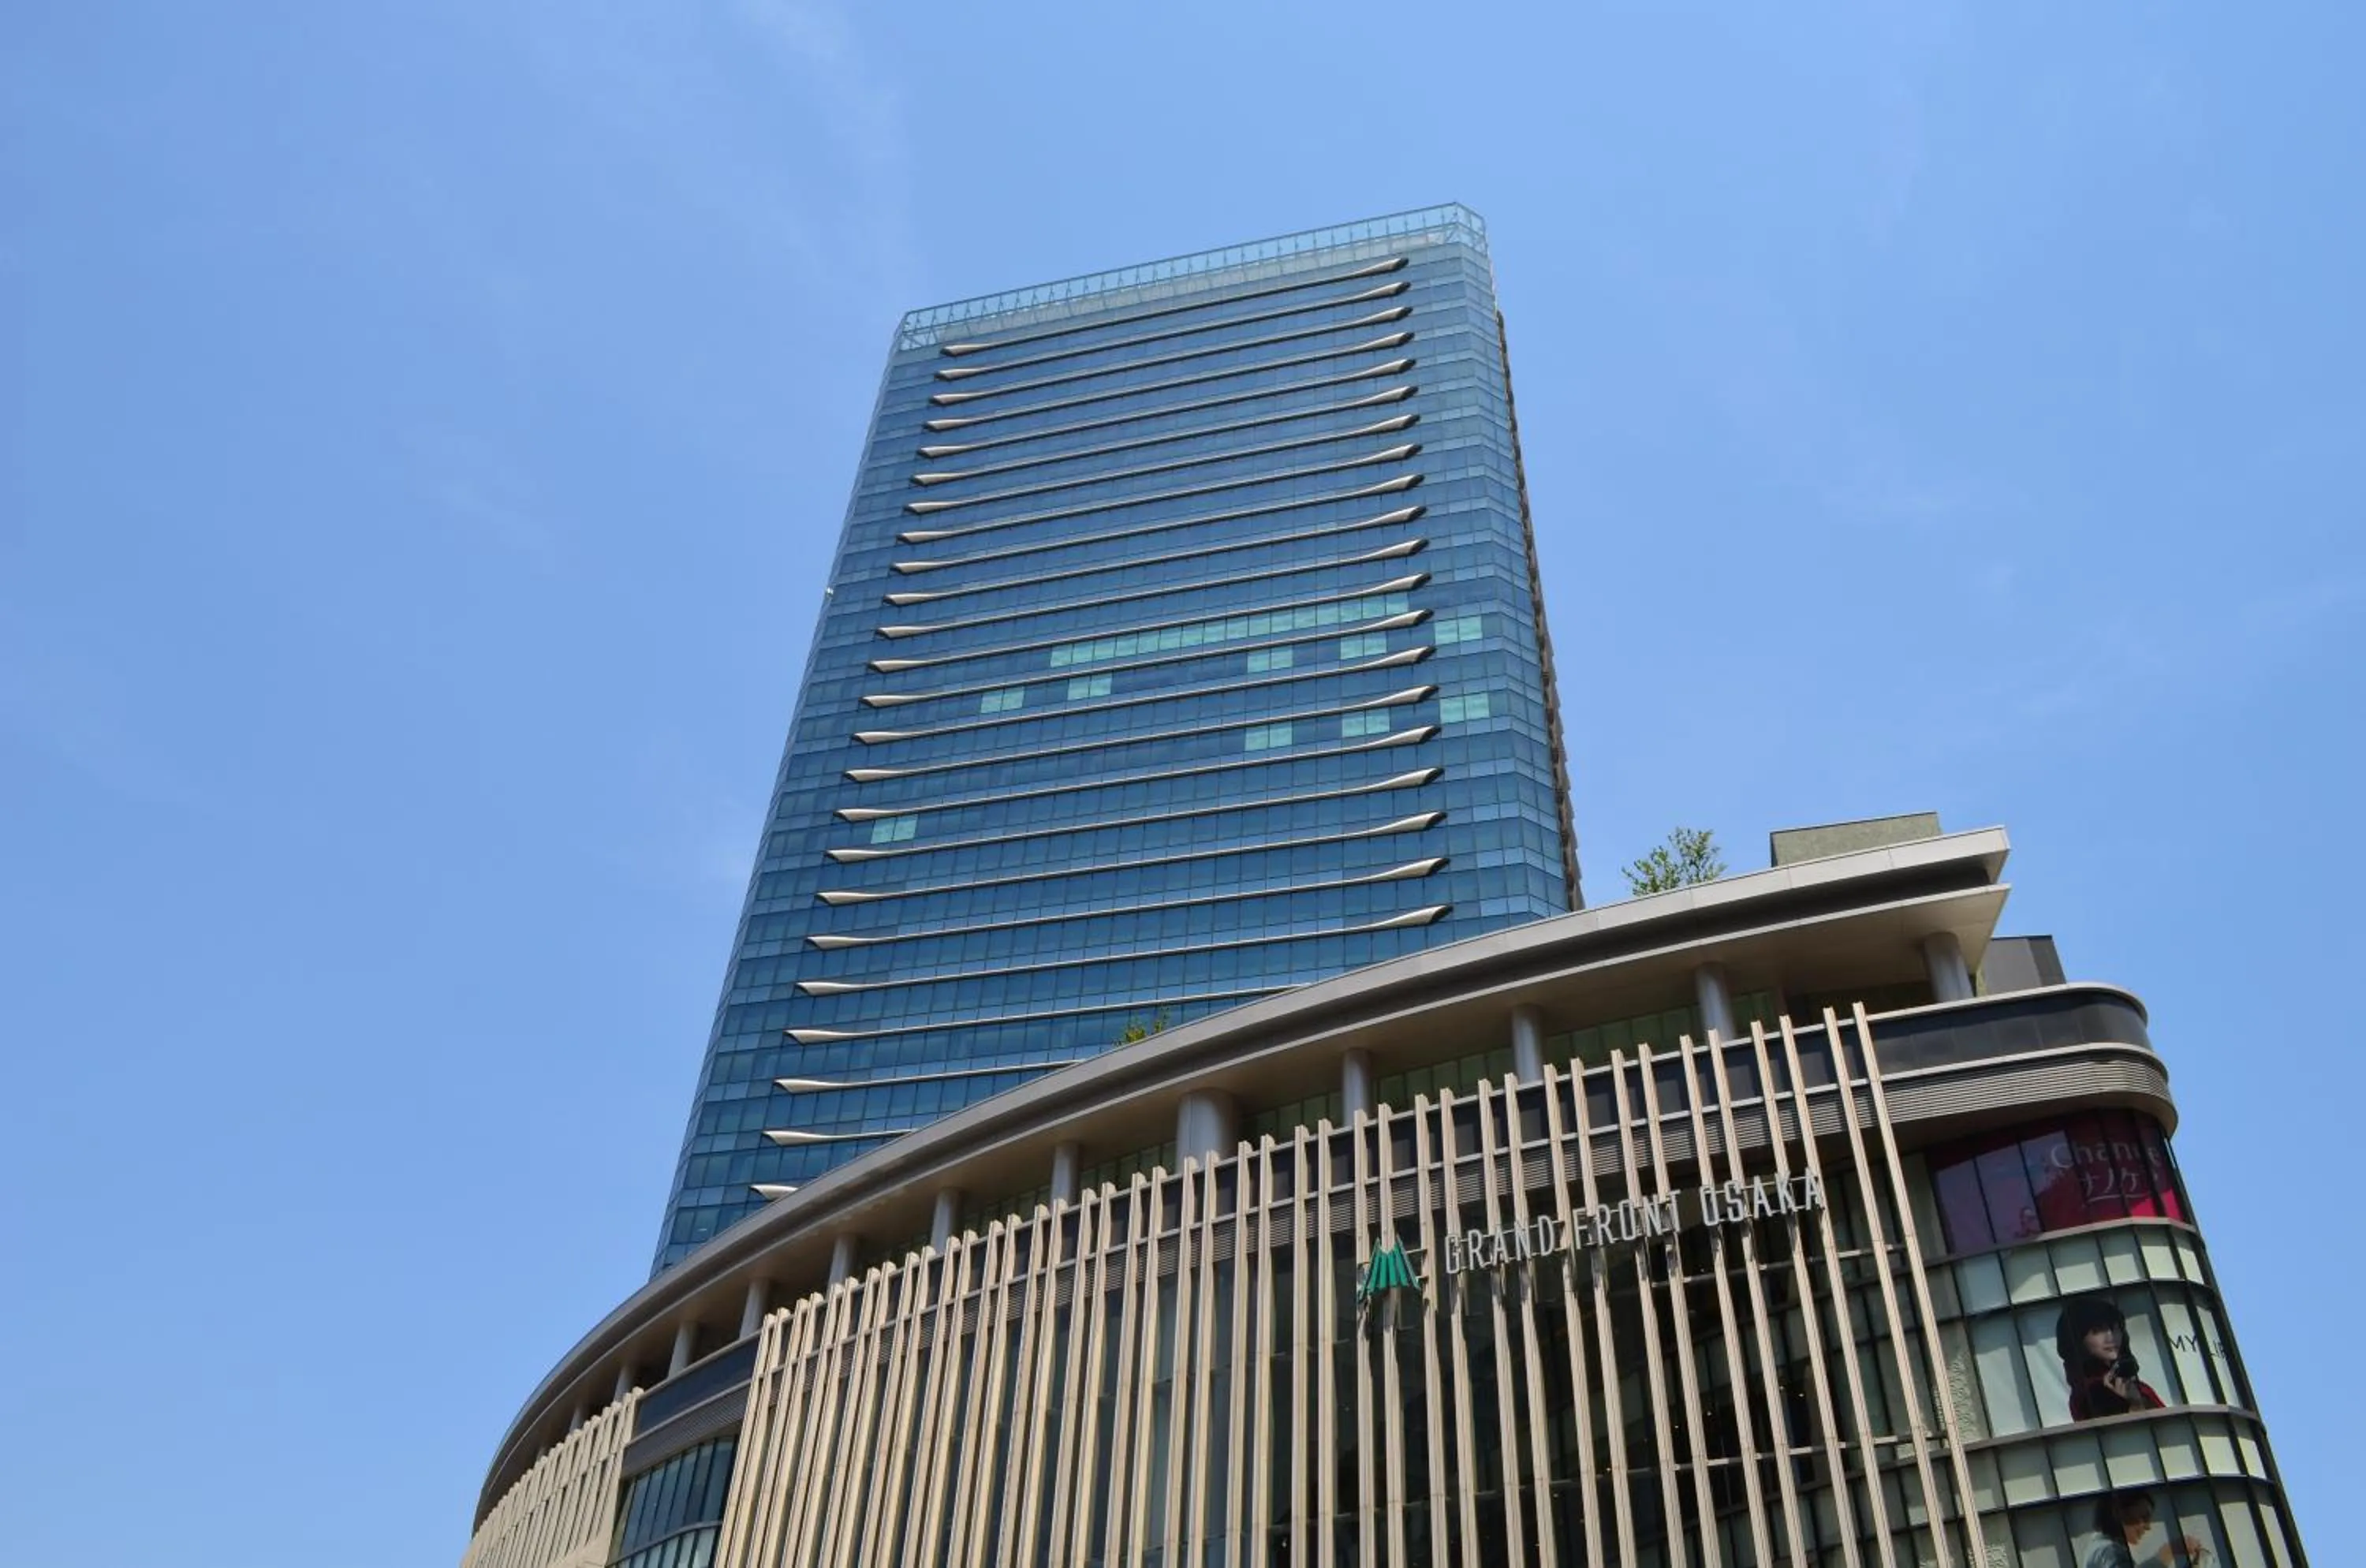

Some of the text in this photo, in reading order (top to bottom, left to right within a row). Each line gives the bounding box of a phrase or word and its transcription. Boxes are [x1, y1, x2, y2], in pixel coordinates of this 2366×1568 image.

[1445, 1167, 1825, 1275] GRAND FRONT OSAKA
[2166, 1335, 2197, 1353] MY
